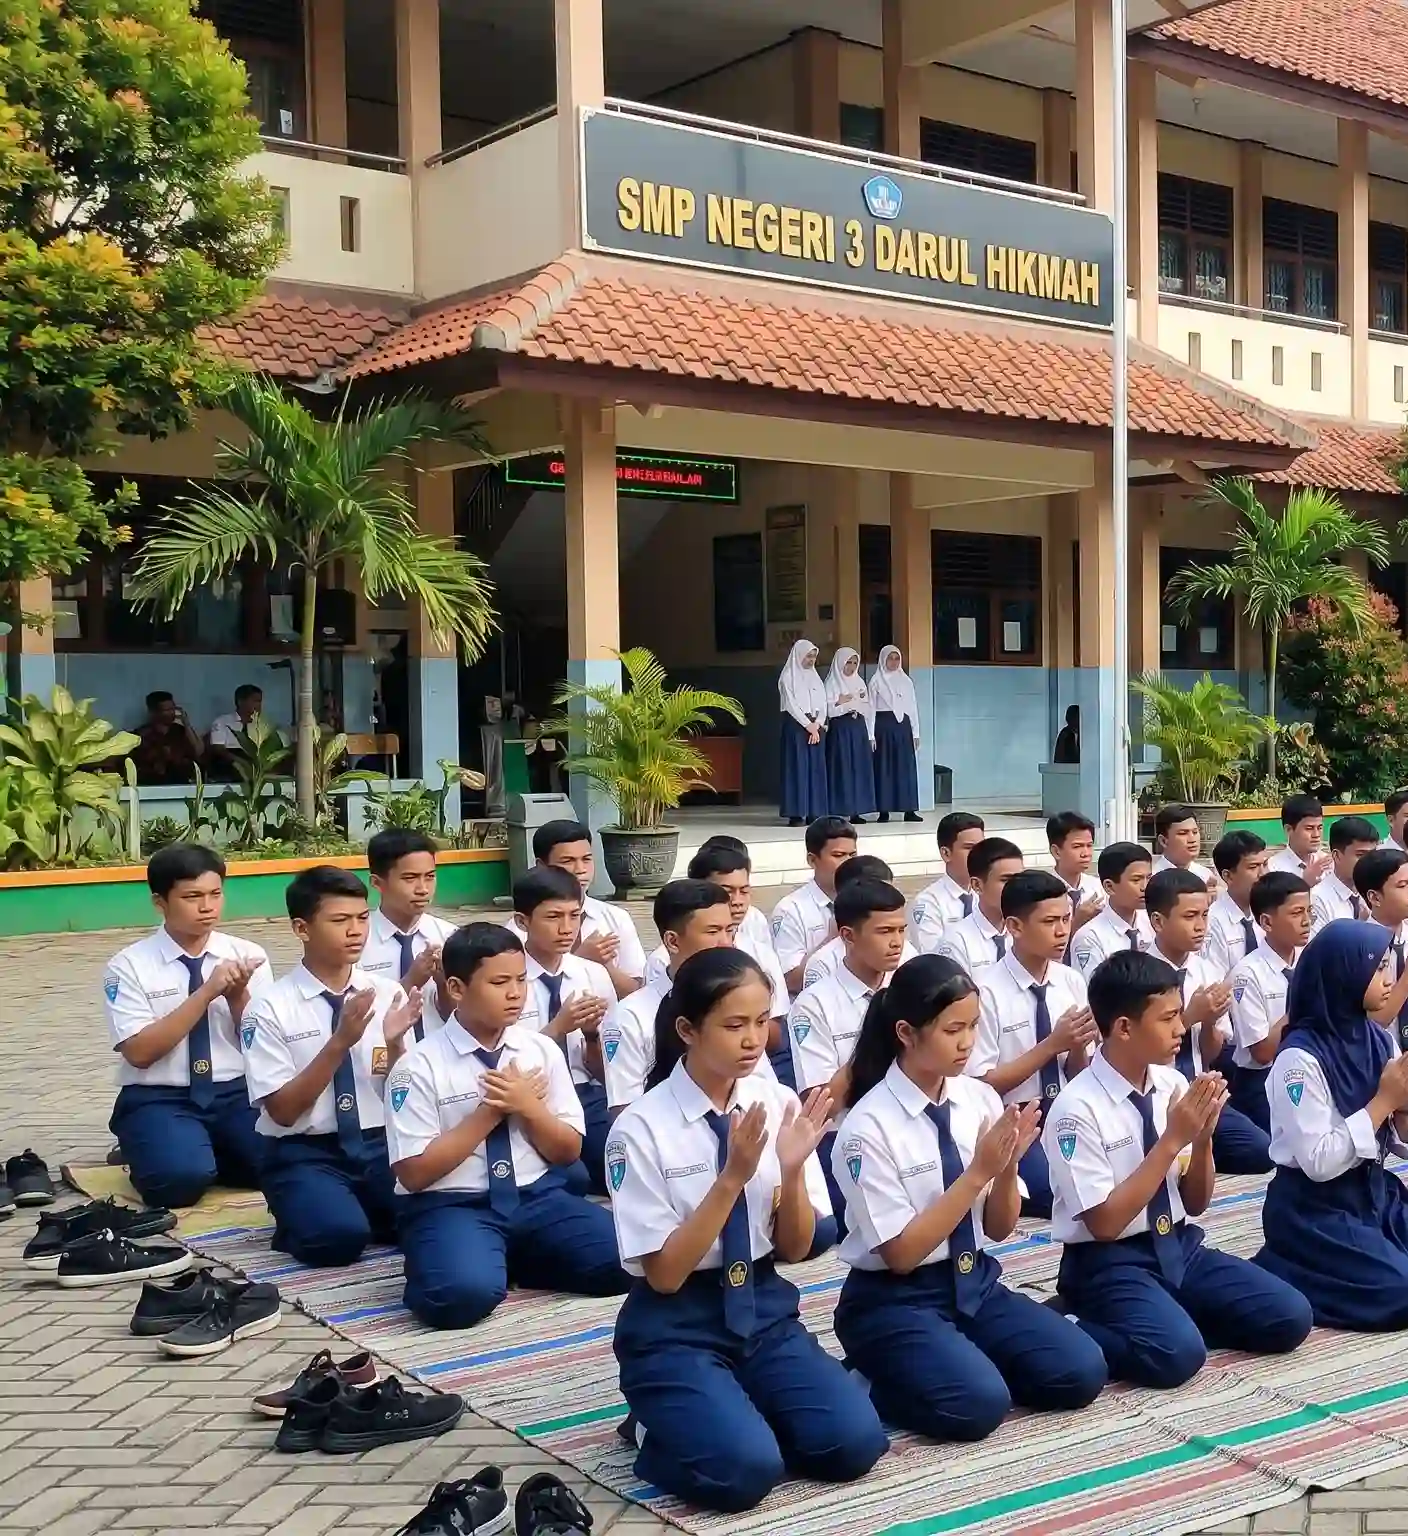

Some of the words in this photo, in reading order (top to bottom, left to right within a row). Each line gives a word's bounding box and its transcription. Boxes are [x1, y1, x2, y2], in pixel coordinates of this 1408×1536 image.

[617, 177, 695, 237] SMP
[706, 195, 835, 263] NEGERI
[845, 219, 865, 267] 3
[875, 225, 977, 286] DARUL
[986, 245, 1099, 306] HIKMAH
